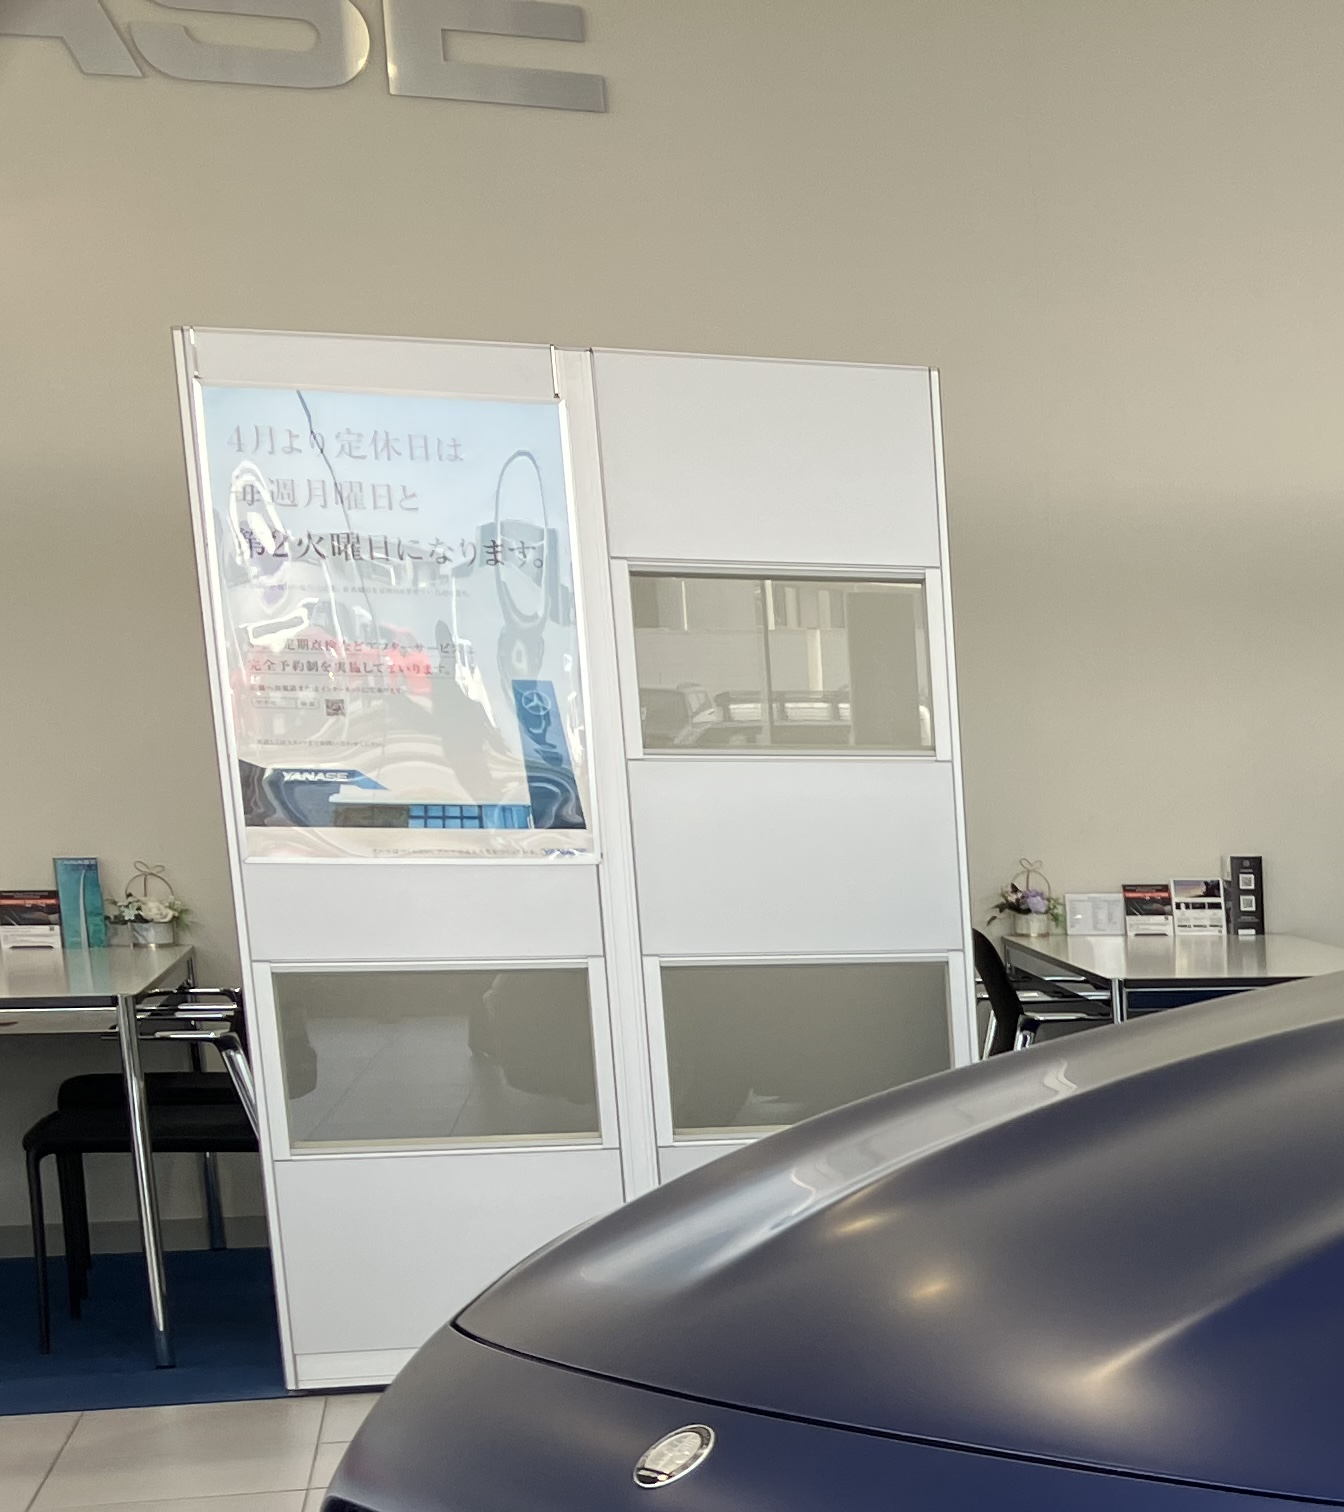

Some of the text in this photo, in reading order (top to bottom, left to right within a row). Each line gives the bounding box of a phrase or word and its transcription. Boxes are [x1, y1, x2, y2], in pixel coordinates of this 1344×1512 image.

[0, 0, 607, 112] SE
[226, 424, 465, 463] 4月より定休日は
[281, 770, 350, 782] YANASE
